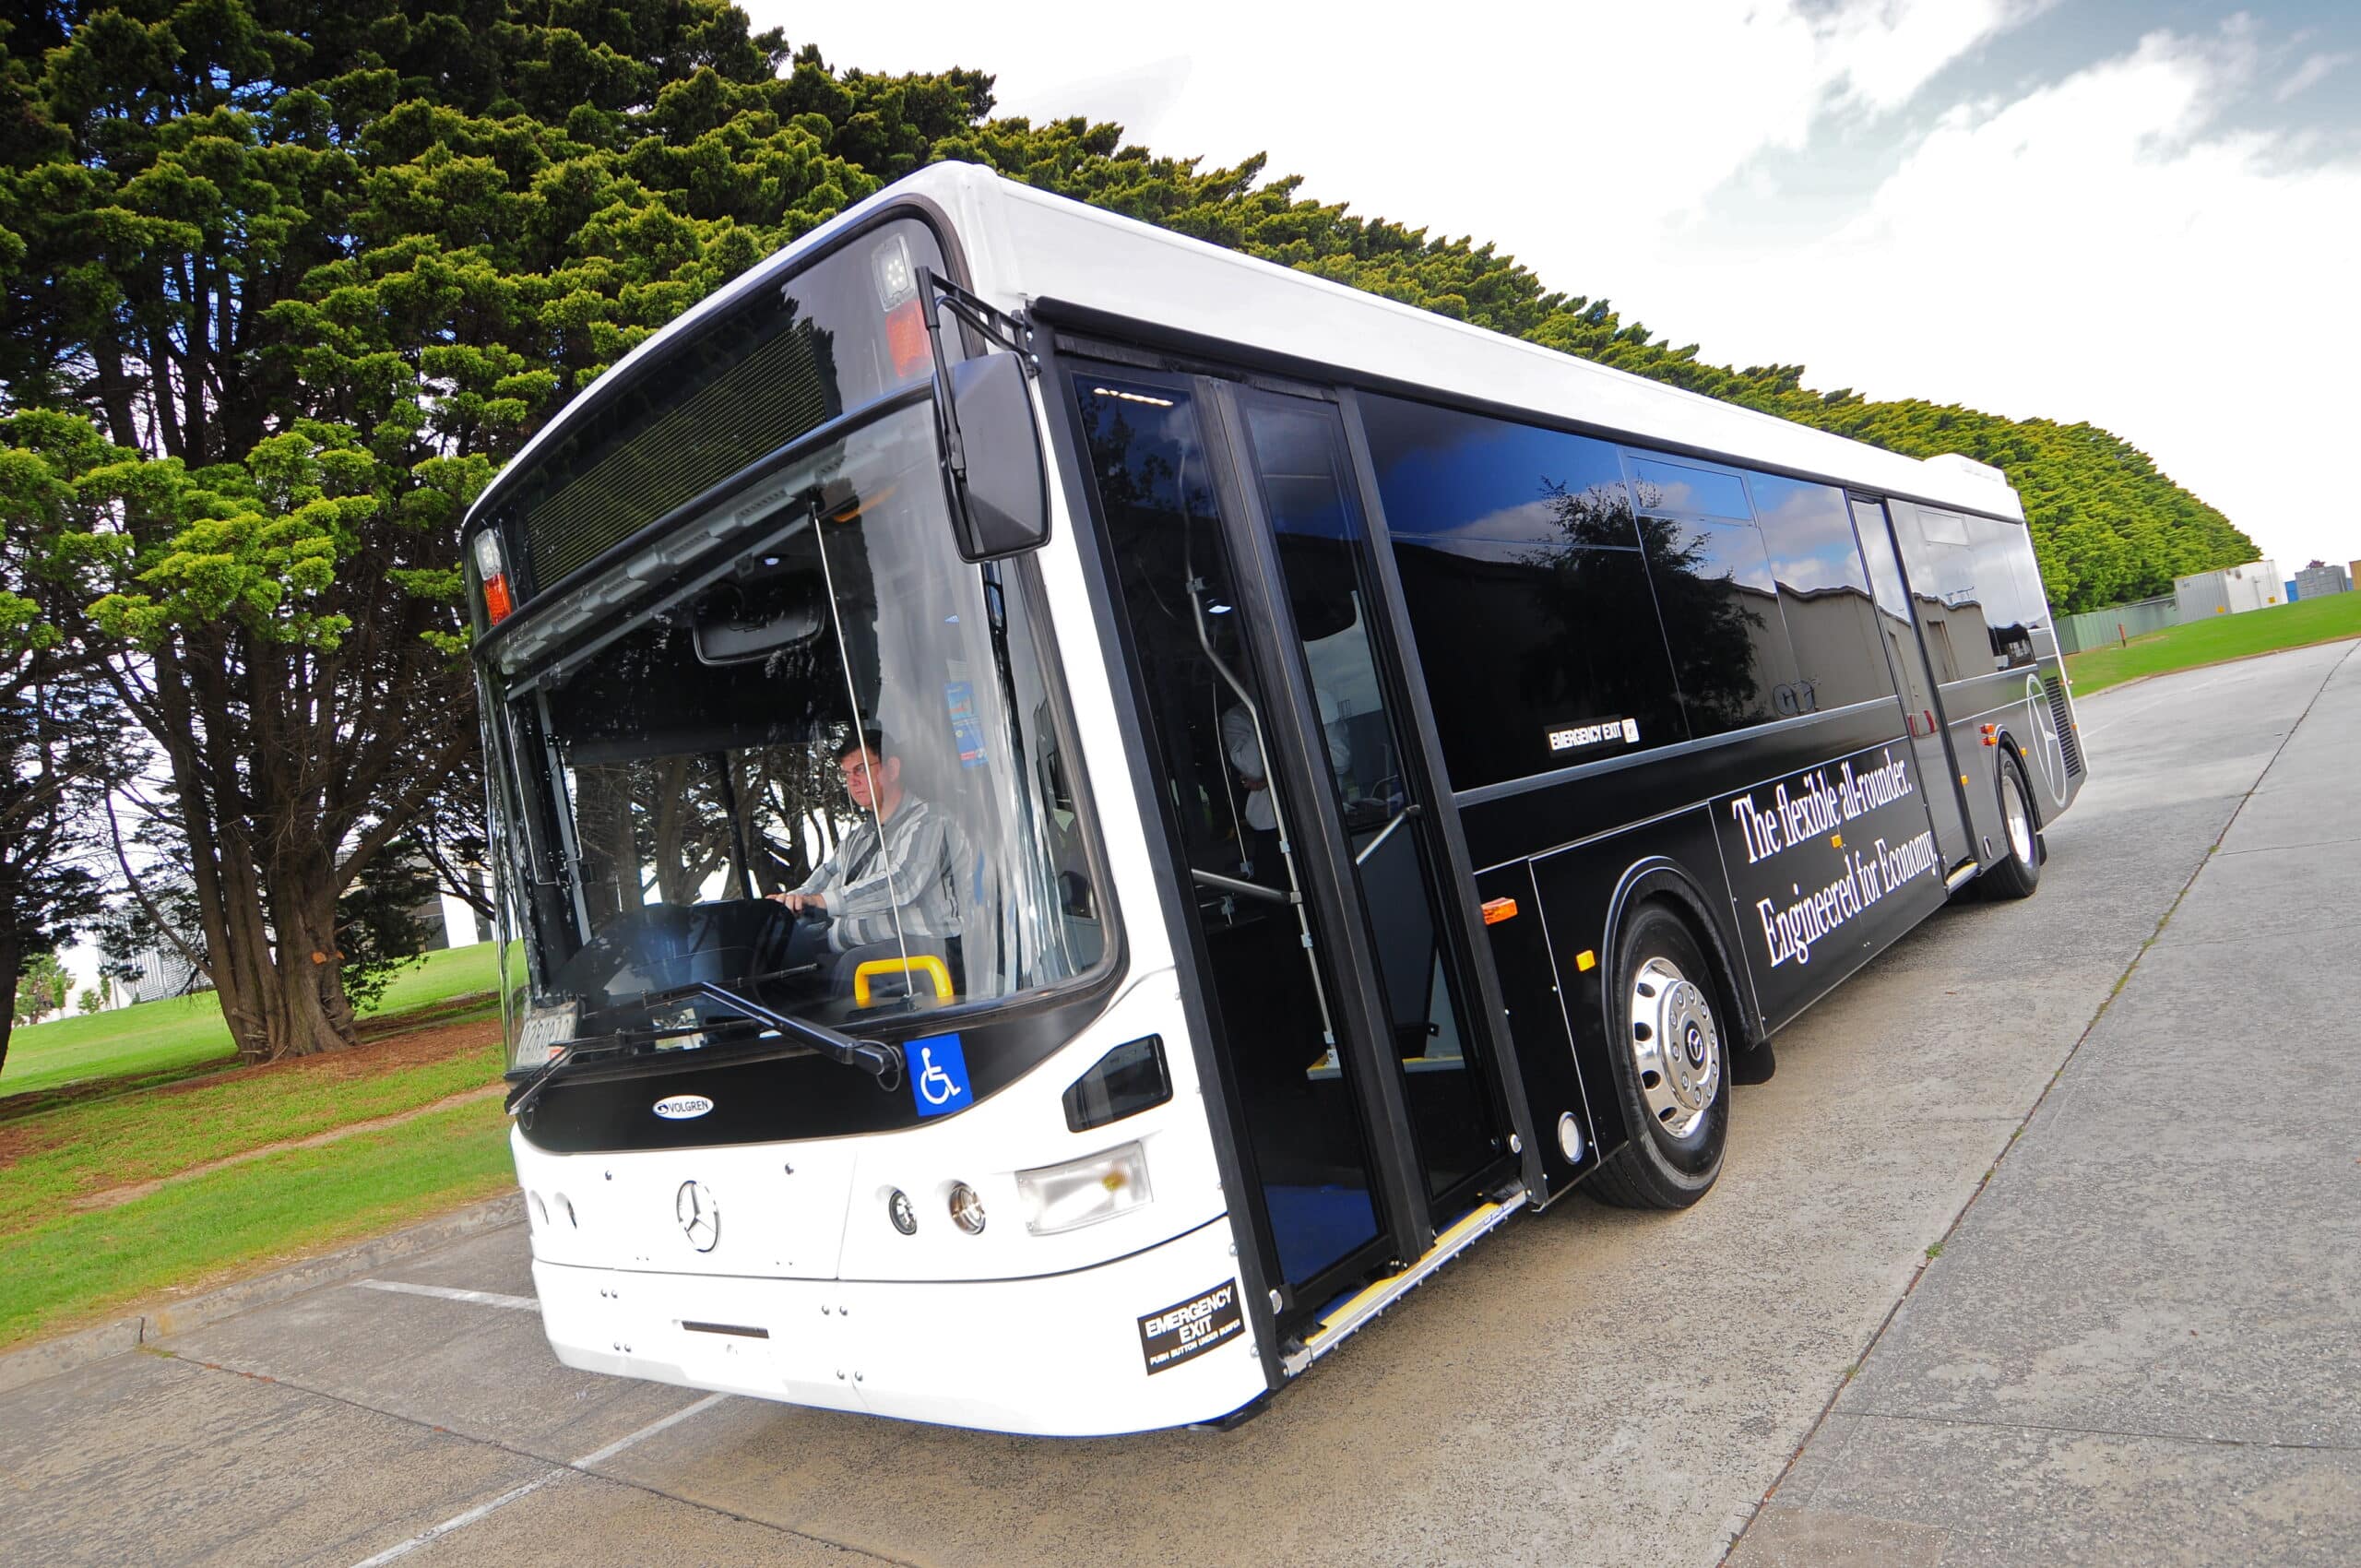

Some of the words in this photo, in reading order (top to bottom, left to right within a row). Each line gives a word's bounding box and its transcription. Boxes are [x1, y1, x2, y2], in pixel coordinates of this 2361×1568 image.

[1548, 725, 1602, 750] EMERGENCY
[1602, 721, 1621, 740] EXIT
[1732, 793, 1782, 863] The
[1775, 767, 1841, 848] flexible
[1839, 748, 1913, 821] all-rounder.
[1756, 854, 1862, 968] Engineered
[1855, 850, 1882, 908] for
[1874, 830, 1939, 893] Economy.
[668, 1099, 709, 1113] VOLGREN
[1145, 1286, 1232, 1338] EMERGENCY
[1179, 1314, 1213, 1344] EXIT
[1149, 1351, 1170, 1366] PUSH
[1170, 1339, 1198, 1358] BUTTON
